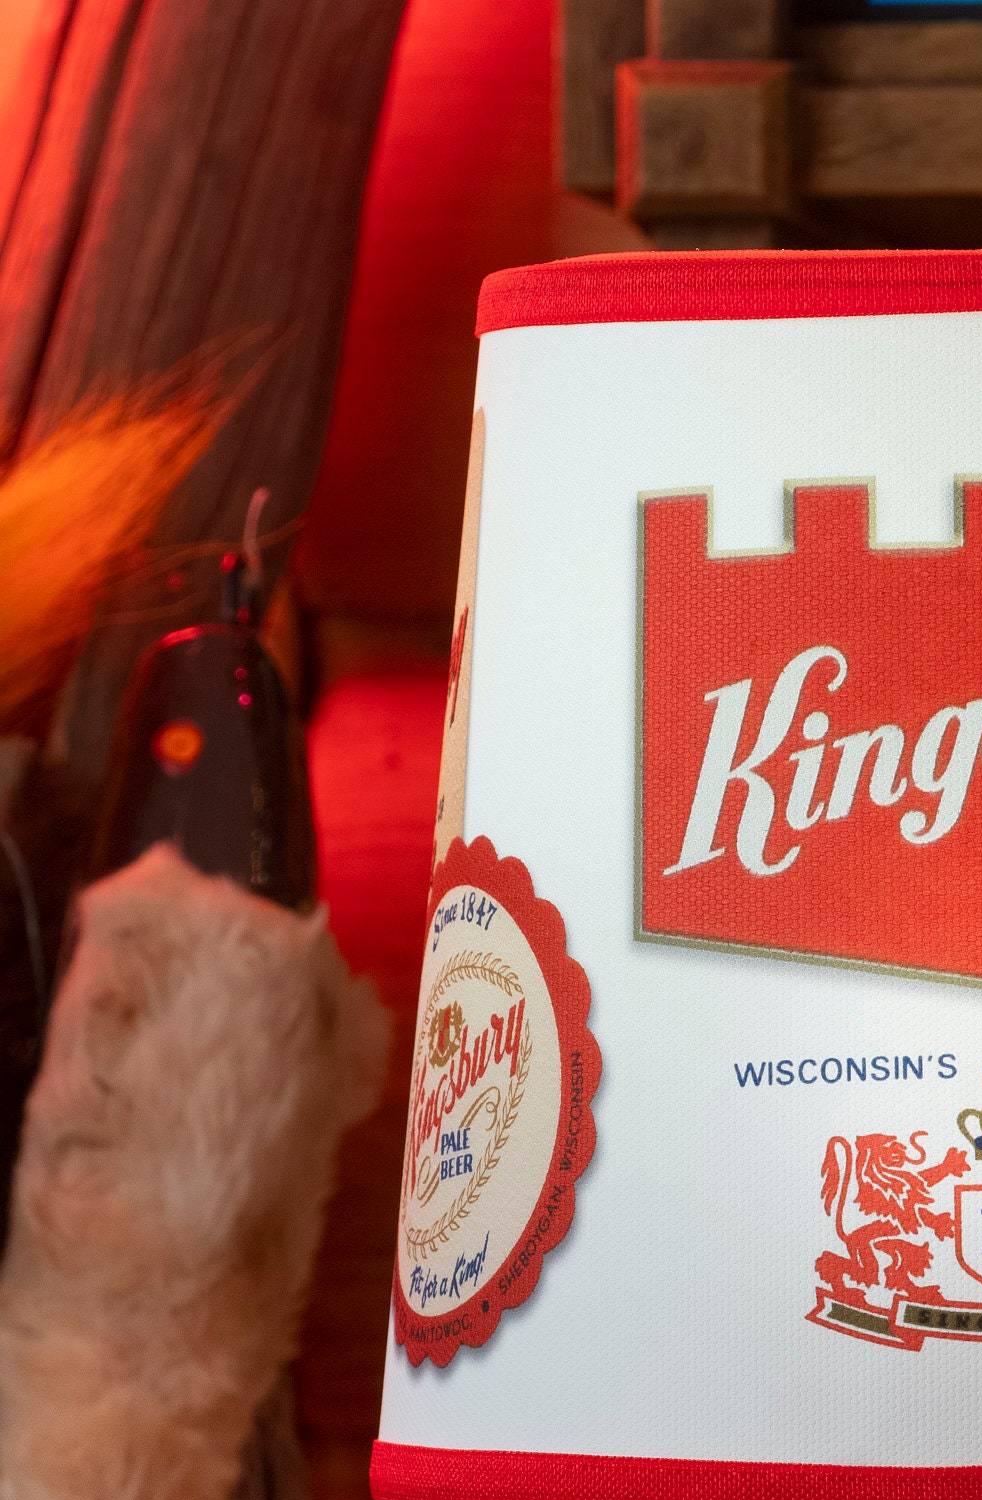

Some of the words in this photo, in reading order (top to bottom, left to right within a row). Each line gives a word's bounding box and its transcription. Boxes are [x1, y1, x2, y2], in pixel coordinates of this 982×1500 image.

[432, 902, 458, 953] Since
[460, 891, 498, 931] 1847
[402, 996, 526, 1202] Kingsbury
[733, 1053, 958, 1089] WISCONSIN'S
[440, 1126, 471, 1156] PALE
[558, 1050, 584, 1173] WISCONSIN
[440, 1152, 474, 1181] BEER
[408, 1264, 424, 1298] Fit
[421, 1267, 439, 1310] for
[439, 1276, 449, 1297] a
[449, 1229, 490, 1299] King!
